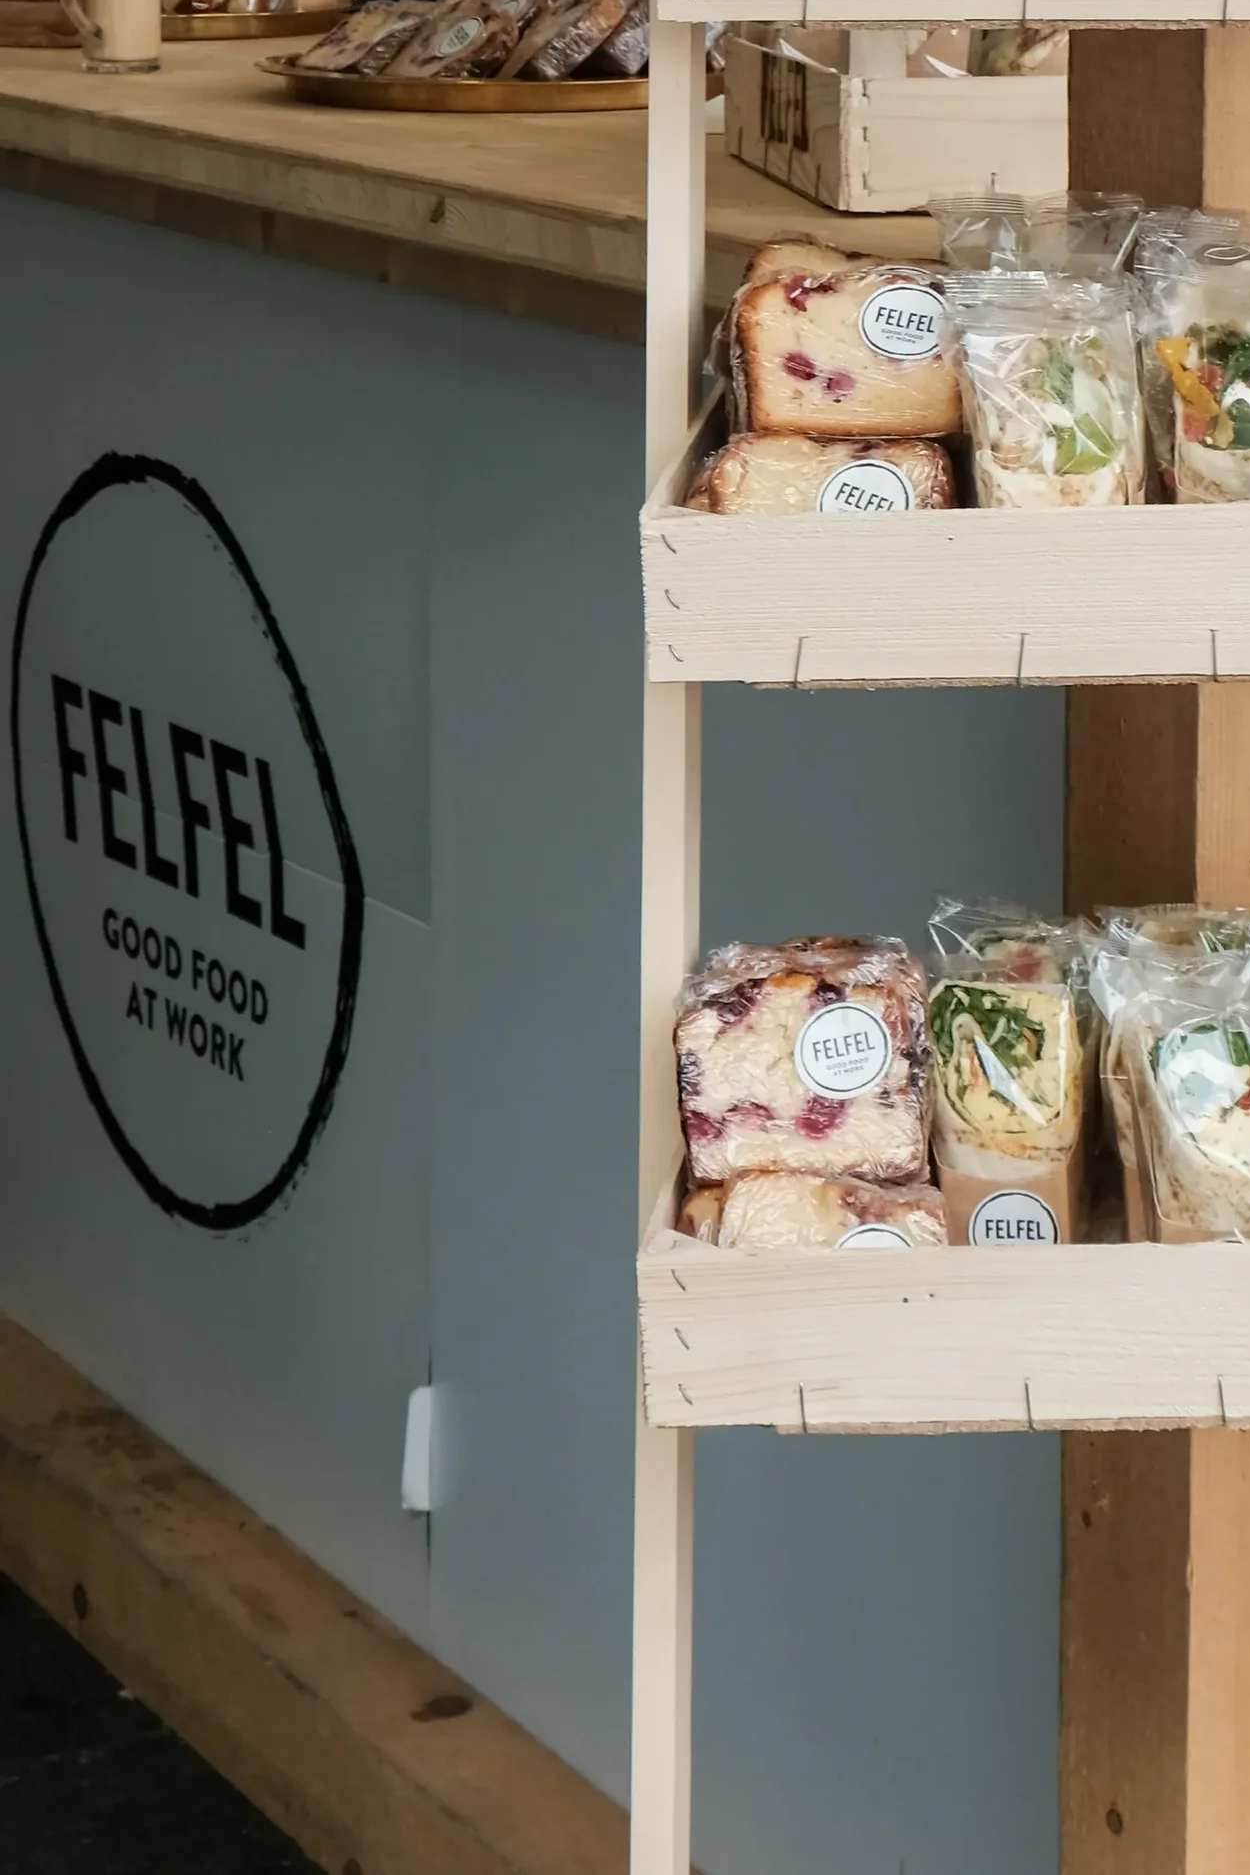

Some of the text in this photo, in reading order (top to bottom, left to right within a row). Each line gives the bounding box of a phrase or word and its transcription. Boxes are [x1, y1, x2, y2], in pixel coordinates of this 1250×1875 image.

[875, 306, 935, 334] FELFEL
[50, 672, 307, 951] FELFEL
[102, 906, 270, 1027] GOOD FOOD
[124, 980, 246, 1082] AT WORK
[812, 1030, 876, 1062] FELFEL
[985, 1219, 1046, 1240] FELFEL
